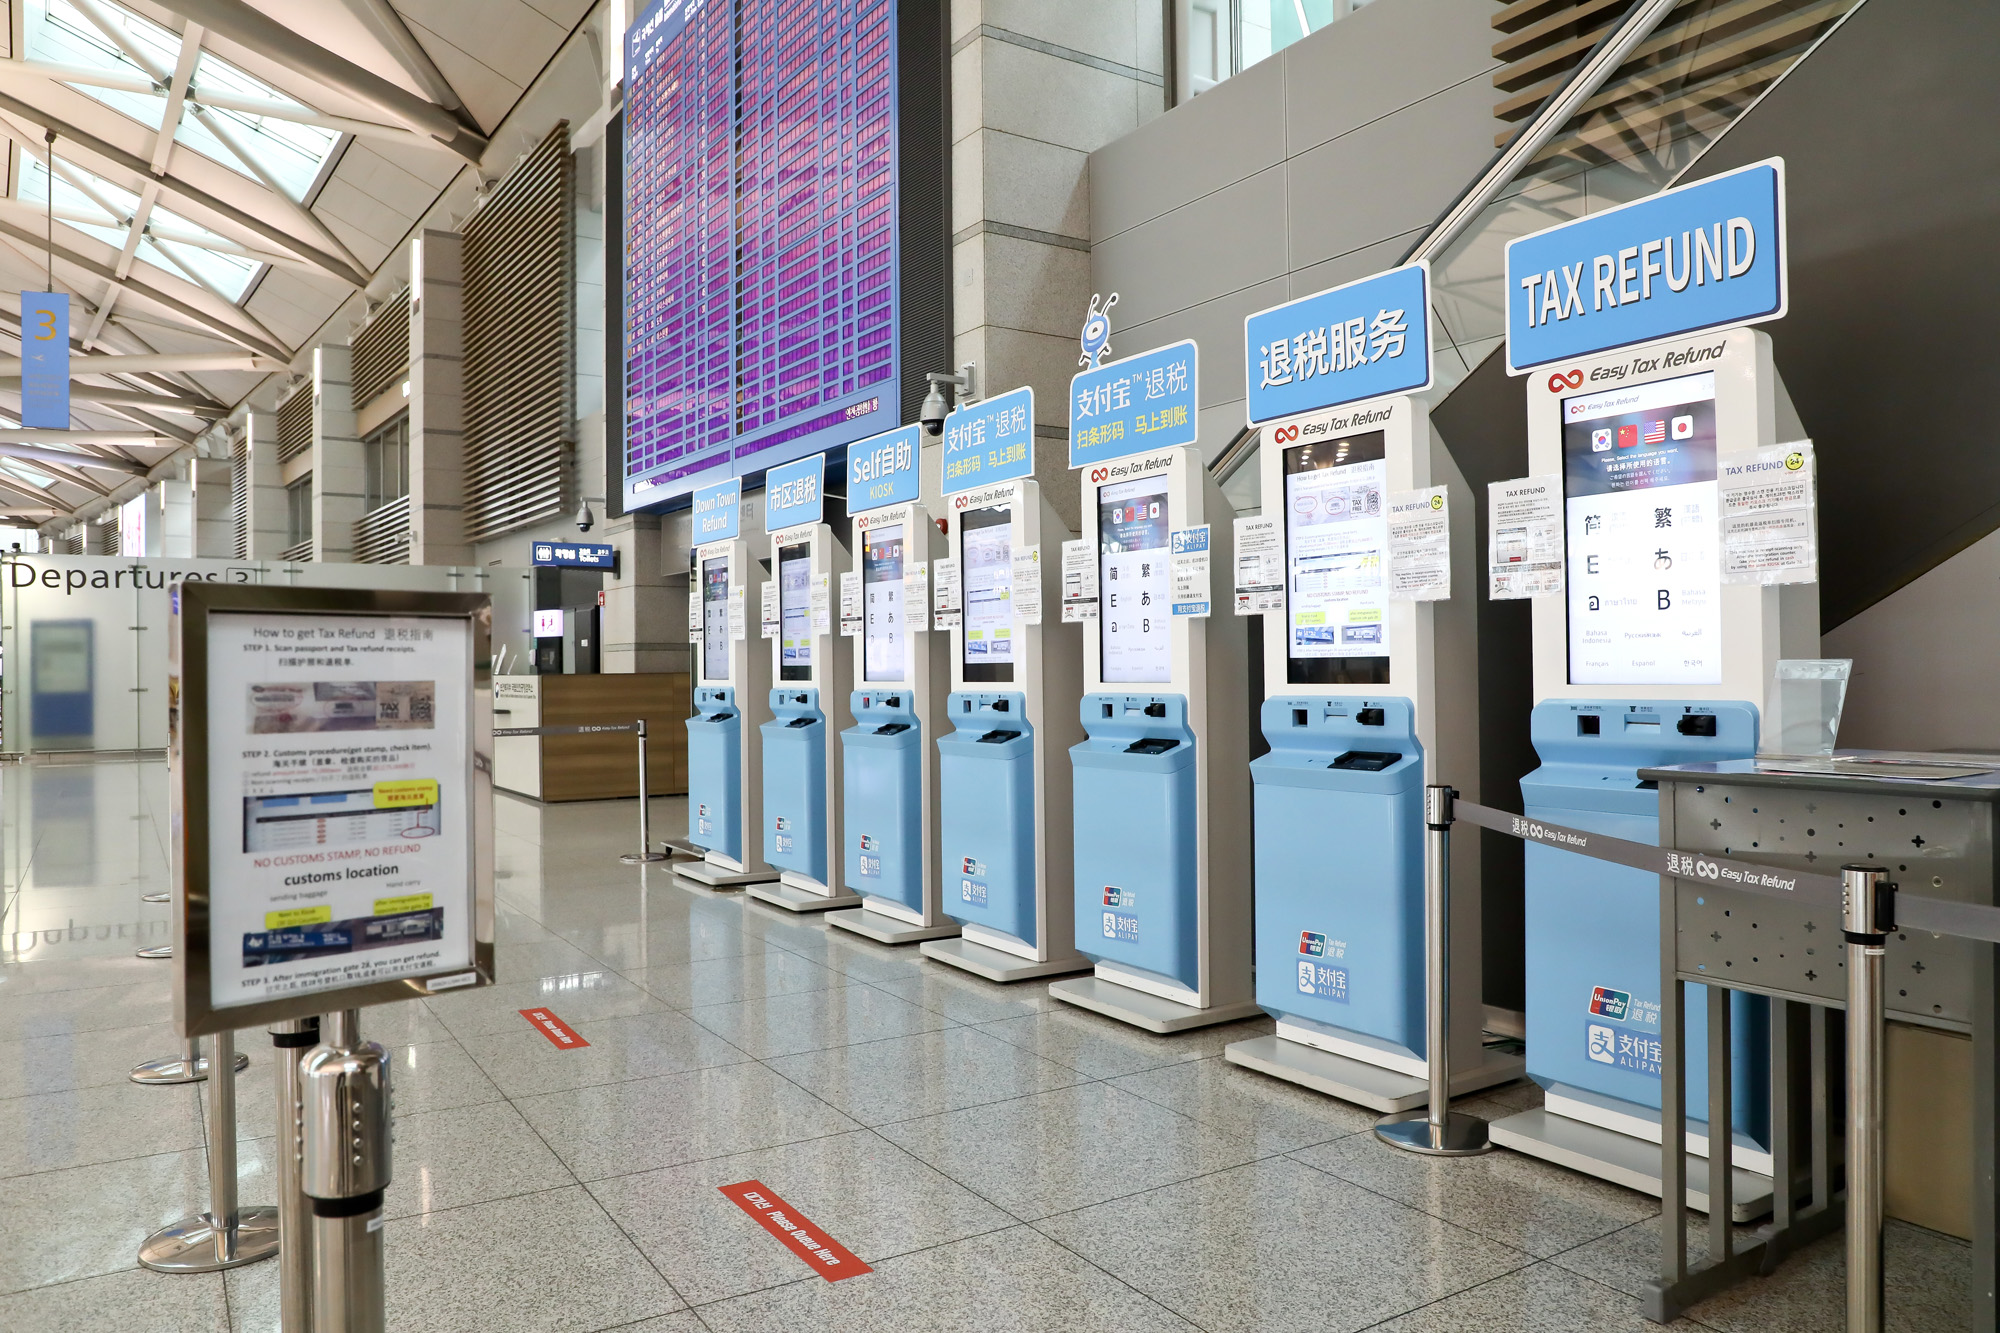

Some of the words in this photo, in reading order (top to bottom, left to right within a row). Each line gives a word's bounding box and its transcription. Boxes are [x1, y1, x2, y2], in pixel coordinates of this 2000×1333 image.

[1521, 261, 1585, 327] TAX
[1593, 216, 1756, 312] REFUND
[35, 309, 57, 341] 3
[1260, 308, 1409, 390] 退税服务
[1590, 358, 1628, 382] Easy
[1631, 352, 1659, 376] Tax
[1663, 340, 1727, 370] Refund
[1145, 360, 1188, 401] 退税
[995, 404, 1026, 439] 退税
[1077, 420, 1125, 450] 扫条形码
[1134, 404, 1188, 434] 马上到账
[1302, 424, 1328, 436] Easy
[1330, 418, 1348, 431] Tax
[1351, 406, 1393, 427] Refund
[853, 438, 912, 484] Self自助
[947, 455, 981, 480] 扫条形码
[988, 442, 1026, 468] 马上到账
[1111, 465, 1129, 477] Easy
[1129, 462, 1143, 474] Tax
[1144, 454, 1173, 471] Refund
[1726, 466, 1742, 476] TAX
[1746, 460, 1784, 473] REFUND
[770, 473, 817, 512] 市区退税
[869, 481, 895, 500] KIOSK
[1506, 490, 1518, 498] TAX
[1519, 487, 1546, 496] REFUND
[695, 496, 715, 514] Down
[716, 491, 736, 509] Town
[702, 511, 728, 533] Refund
[1587, 555, 1599, 575] E
[11, 562, 218, 595] Departures
[1657, 589, 1671, 610] B
[254, 628, 279, 638] How
[283, 628, 294, 638] to
[297, 630, 314, 640] get
[318, 629, 335, 639] Tax
[338, 628, 375, 639] Refund
[384, 628, 433, 641] 退税指南
[1143, 618, 1150, 633] B
[243, 644, 263, 652] STEP
[274, 644, 290, 652] Scan
[294, 645, 328, 653] passport
[360, 645, 384, 653] refund
[380, 702, 400, 711] TAX
[273, 749, 307, 757] Customs
[1512, 817, 1529, 836] 退税
[1544, 829, 1557, 842] Easy
[1557, 831, 1567, 843] Tax
[1566, 833, 1588, 847] Refund
[253, 858, 270, 868] NO
[273, 853, 325, 867] CUSTOMS
[327, 849, 361, 863] STAMP,
[364, 846, 380, 857] NO
[383, 843, 421, 856] REFUND
[284, 869, 342, 886] customs
[346, 863, 399, 879] location
[1667, 852, 1695, 877] 退税
[1721, 868, 1743, 883] Easy
[1743, 870, 1761, 885] Tax
[1760, 874, 1796, 892] Refund
[1117, 917, 1138, 933] 支付宝
[241, 978, 261, 988] STEP
[273, 973, 293, 982] After
[295, 967, 341, 980] immigration
[344, 964, 359, 974] gate
[373, 960, 388, 969] you
[389, 957, 401, 965] can
[404, 956, 415, 965] get
[416, 951, 441, 961] refund.
[1317, 966, 1346, 989] 支付宝
[1319, 986, 1346, 999] ALIPAY
[1594, 993, 1626, 1011] UnionPay
[1631, 1008, 1657, 1024] 退税
[1619, 1034, 1661, 1063] 支付宝
[1620, 1056, 1661, 1074] ALIPAY
[766, 1210, 797, 1231] Please
[790, 1229, 821, 1250] Queue
[813, 1248, 840, 1266] Here
